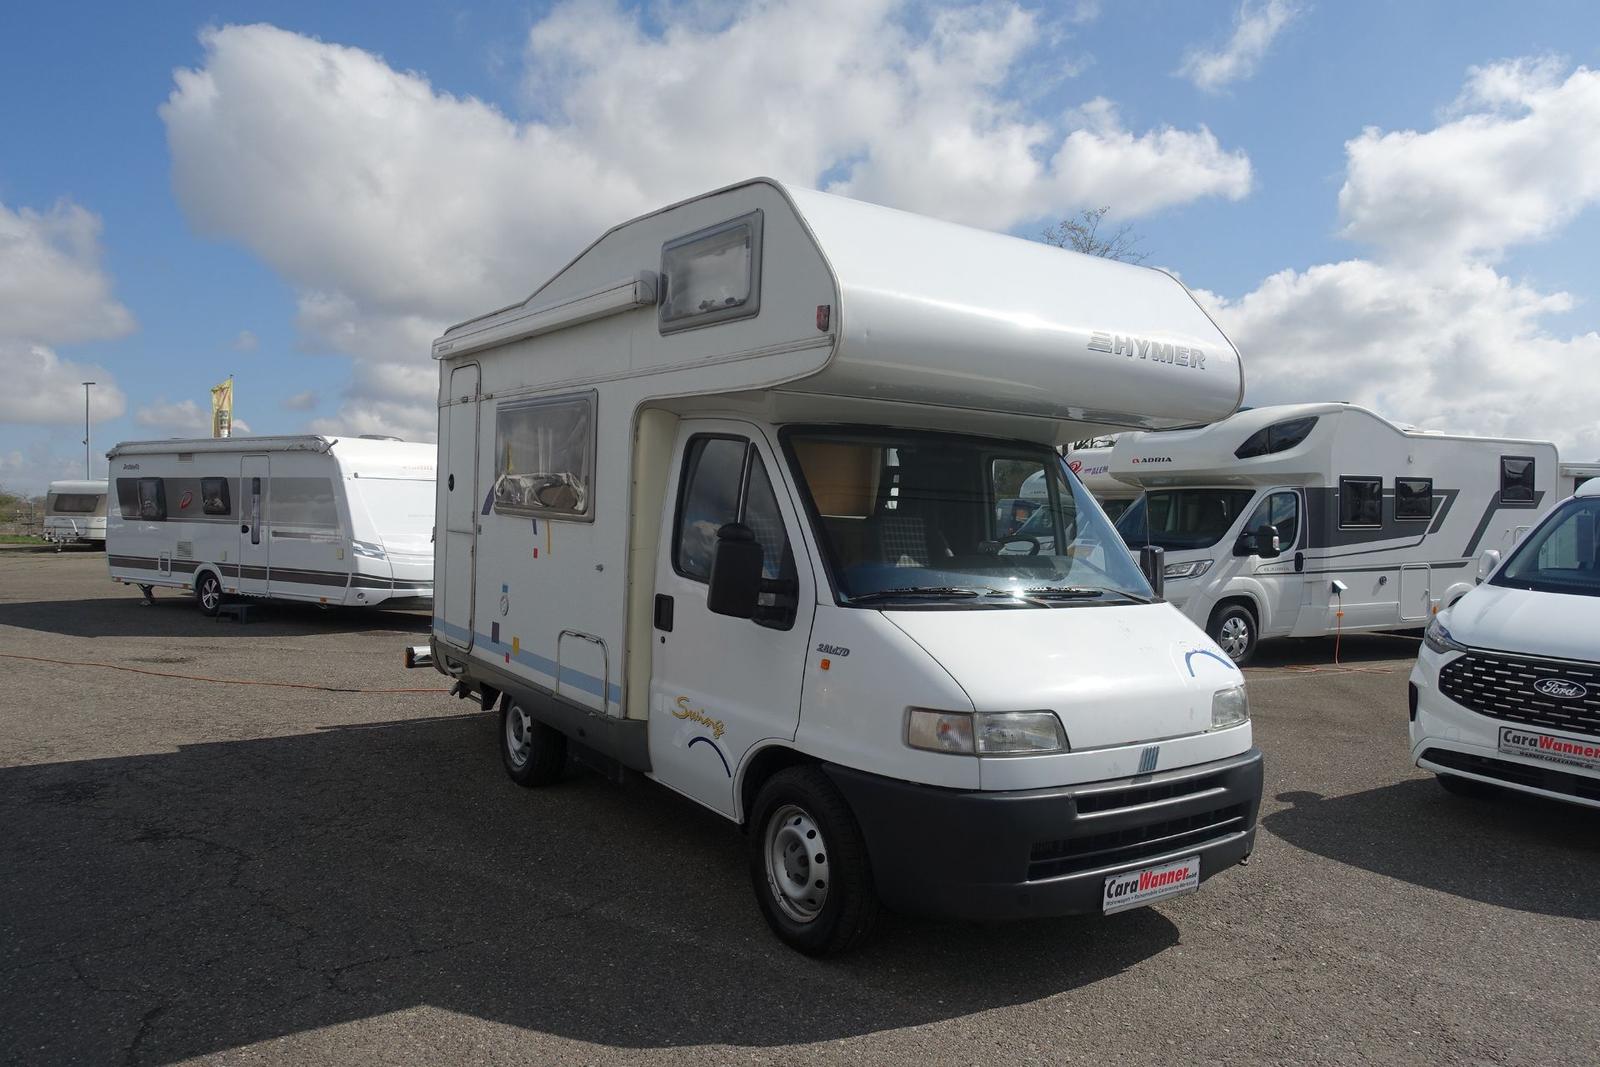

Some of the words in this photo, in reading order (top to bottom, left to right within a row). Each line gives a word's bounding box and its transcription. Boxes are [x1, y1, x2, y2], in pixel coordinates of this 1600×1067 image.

[1113, 335, 1206, 370] HYMER
[1542, 680, 1577, 697] Ford
[671, 696, 725, 740] Swing
[1106, 867, 1189, 899] CaraWanner
